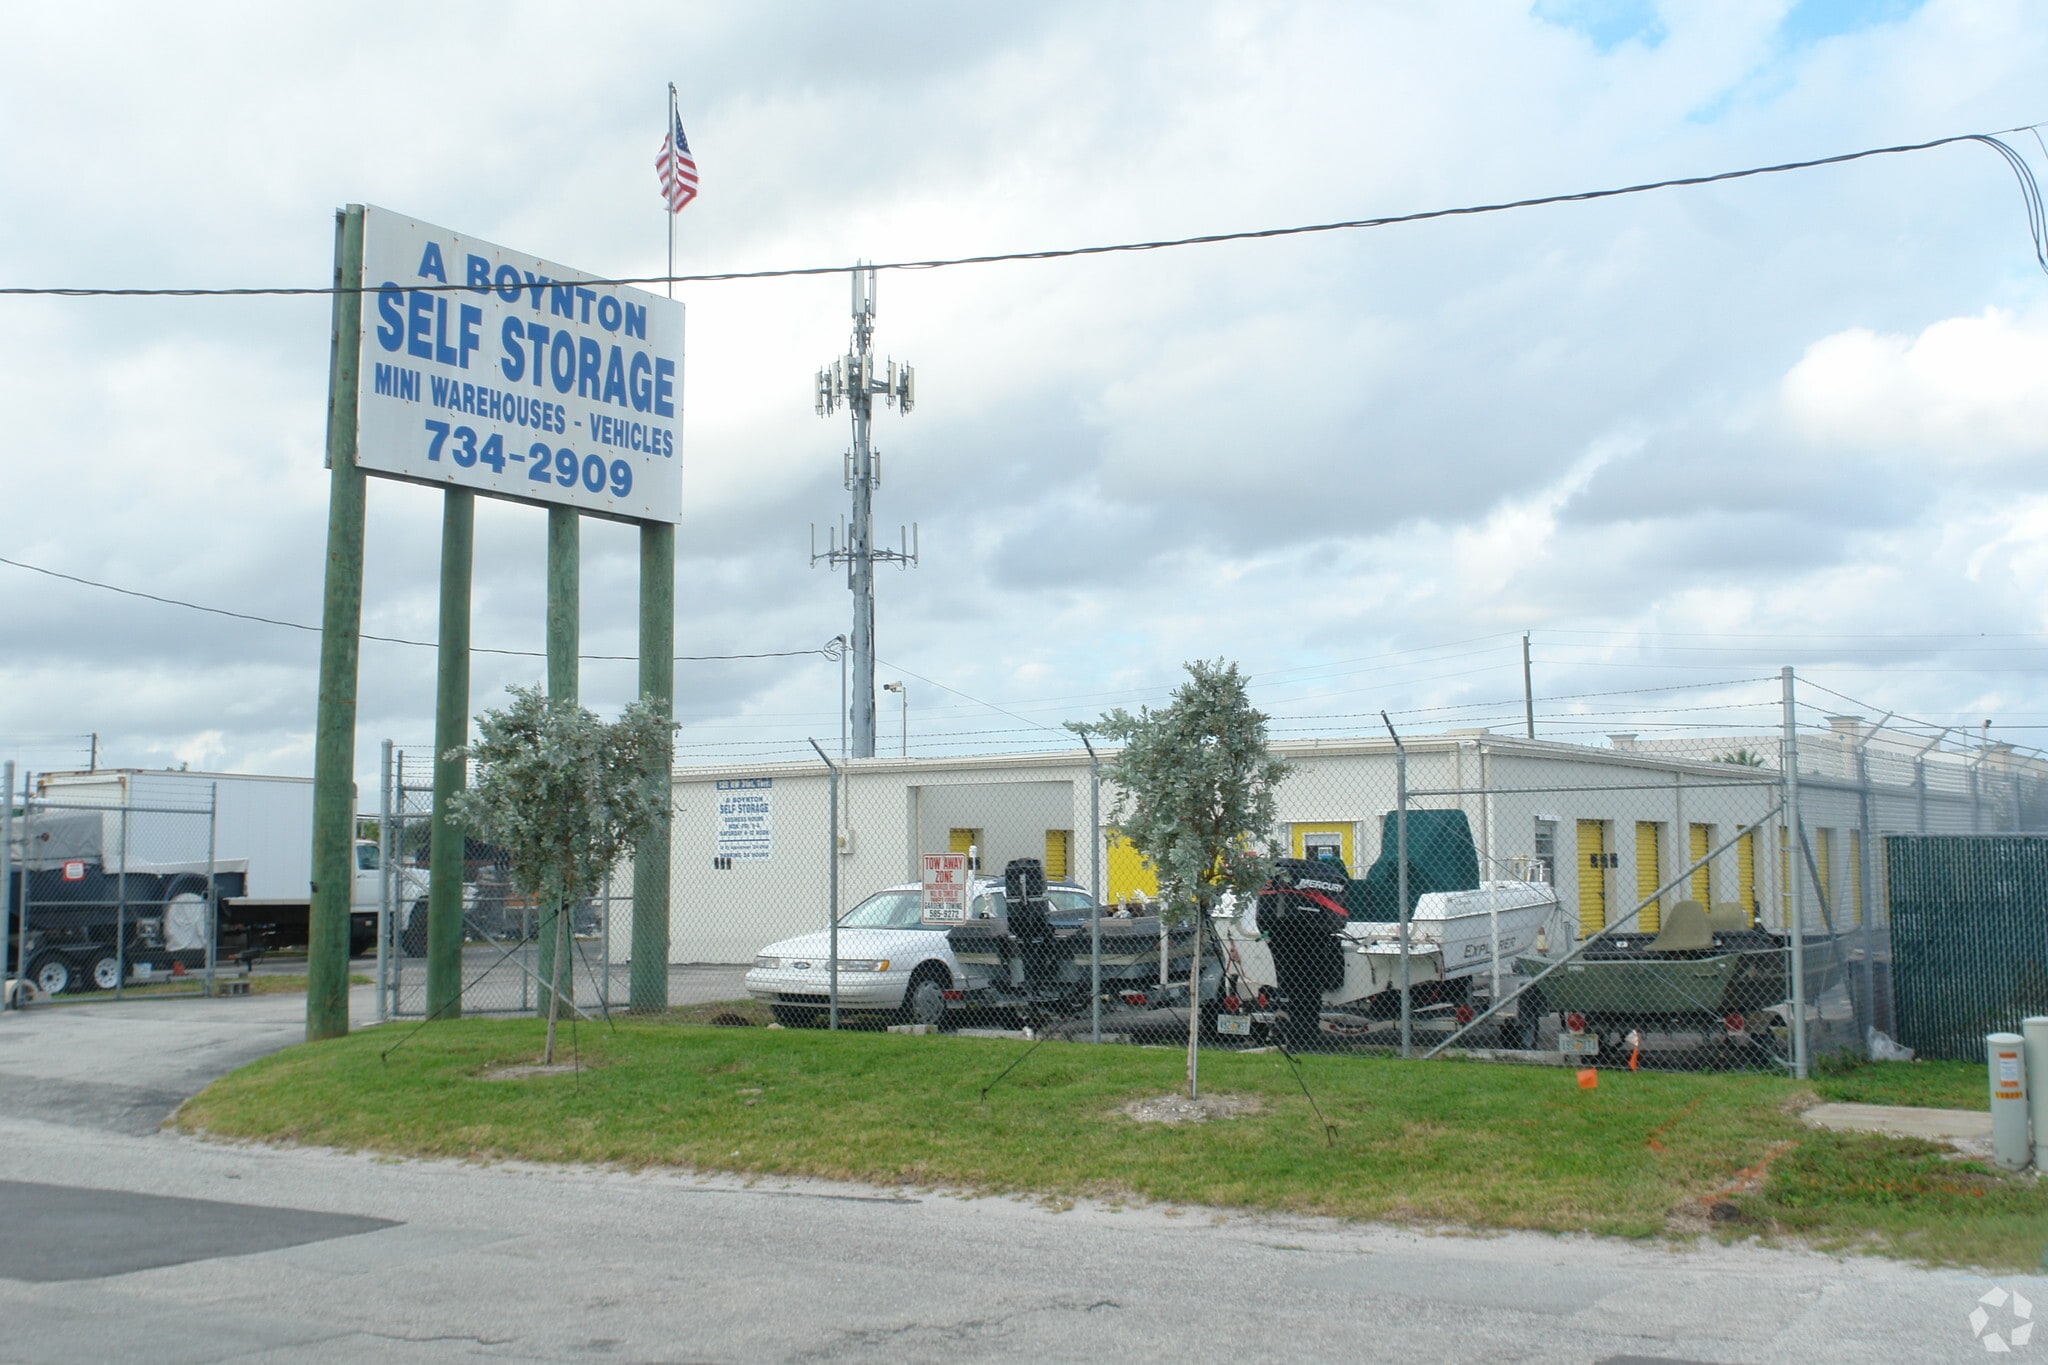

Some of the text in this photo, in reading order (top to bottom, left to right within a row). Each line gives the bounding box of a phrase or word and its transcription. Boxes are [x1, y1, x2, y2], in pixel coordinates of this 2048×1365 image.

[417, 241, 647, 341] A BOYNTON
[376, 281, 675, 419] SELF STORAGE
[374, 362, 421, 403] MINI
[430, 374, 566, 435] WAREHOUSES
[589, 412, 674, 458] VEHICLES
[424, 418, 634, 498] 734-2909
[719, 803, 769, 814] SELF STORAGE
[924, 856, 963, 870] TOW AWAY
[935, 870, 953, 883] ZONE
[1295, 878, 1345, 893] MERCURY
[1463, 936, 1517, 959] EXPLRER
